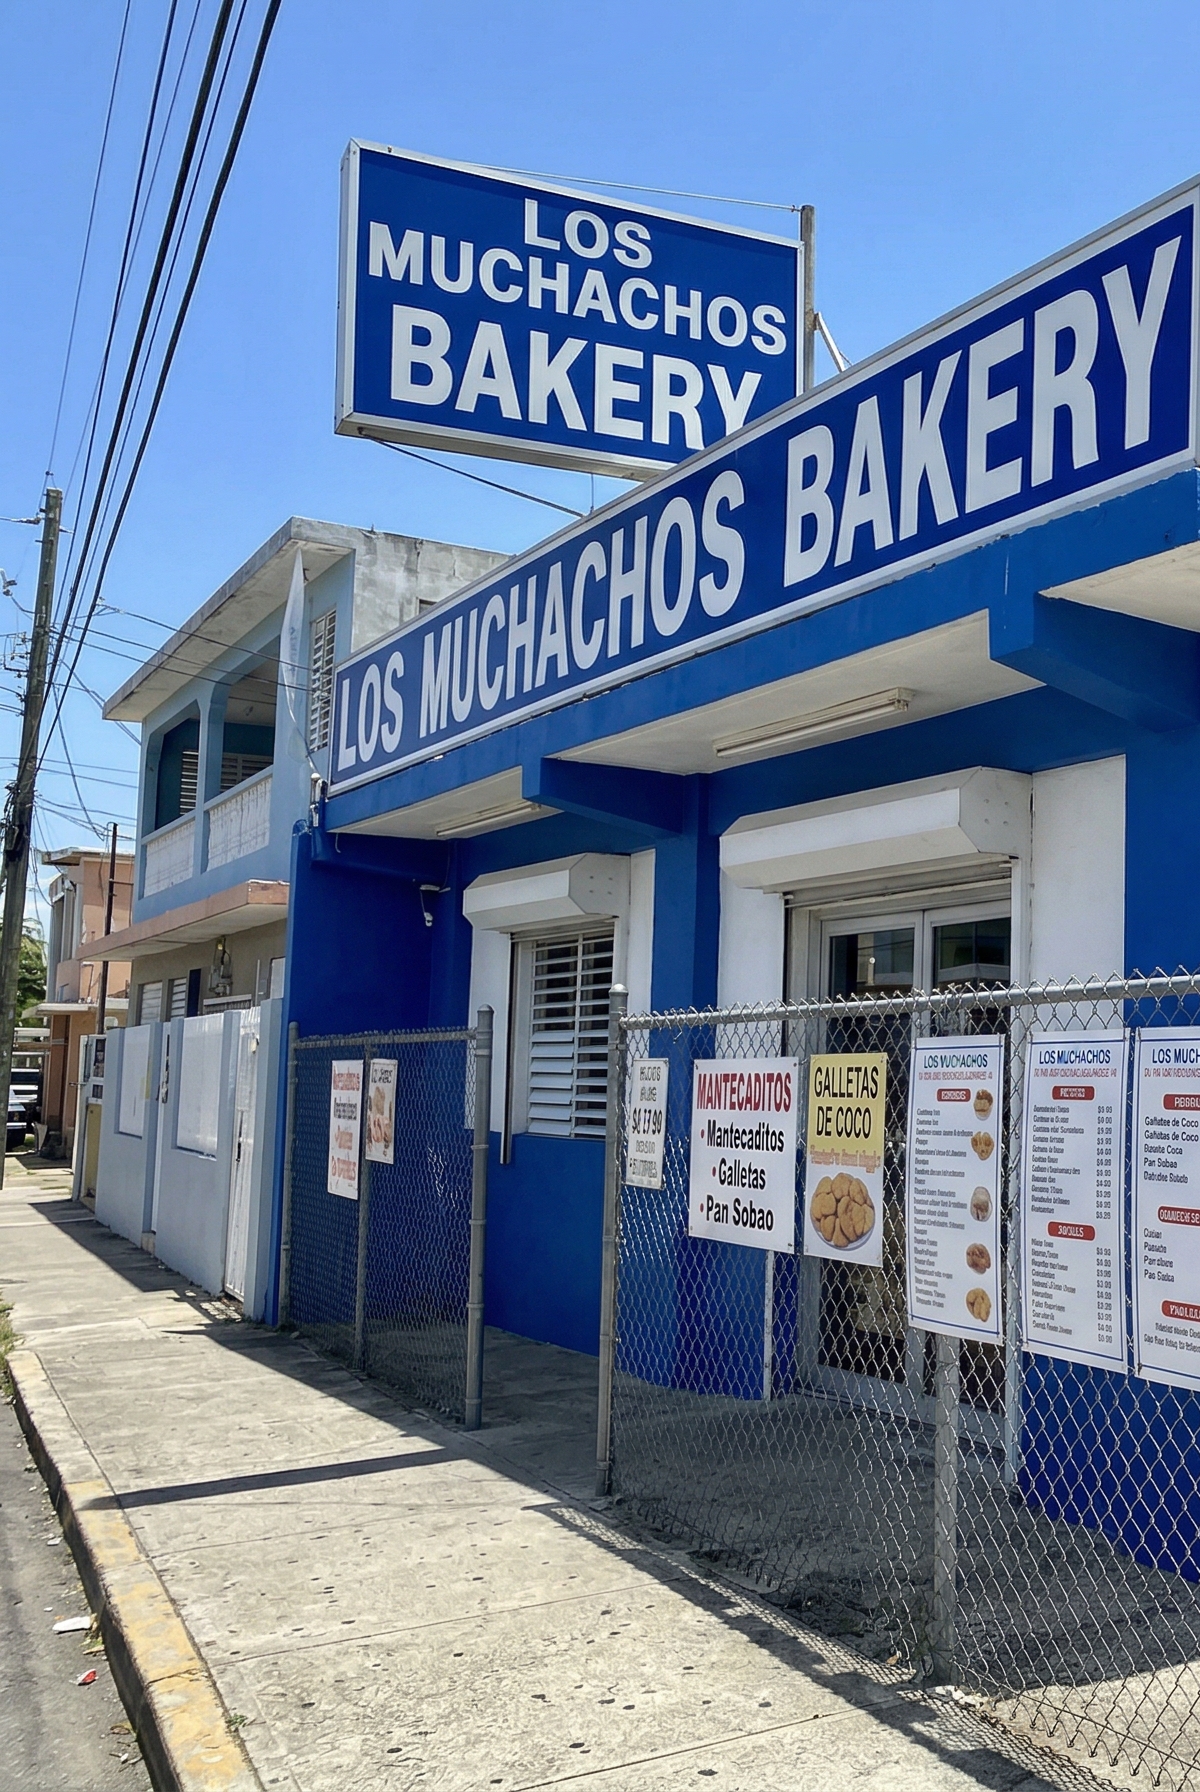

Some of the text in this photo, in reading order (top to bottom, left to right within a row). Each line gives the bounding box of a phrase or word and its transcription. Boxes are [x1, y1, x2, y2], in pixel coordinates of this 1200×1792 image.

[523, 198, 652, 269] LOS
[368, 221, 787, 355] MUCHACHOS
[390, 304, 762, 450] BAKERY
[337, 236, 1181, 772] LOS MUCHACHOS BAKERY
[924, 1055, 938, 1068] LOS
[1039, 1049, 1111, 1064] LOS MUCHACHOS
[1152, 1048, 1171, 1063] LOS
[697, 1071, 792, 1112] MANTECADITOS
[814, 1066, 879, 1099] GALLETAS
[707, 1119, 785, 1152] Mantecaditos
[816, 1106, 872, 1139] DE COCO
[1181, 1117, 1199, 1128] Coco
[1181, 1131, 1199, 1142] Coco
[718, 1157, 766, 1190] Galletas
[706, 1195, 774, 1231] Pan Sobao
